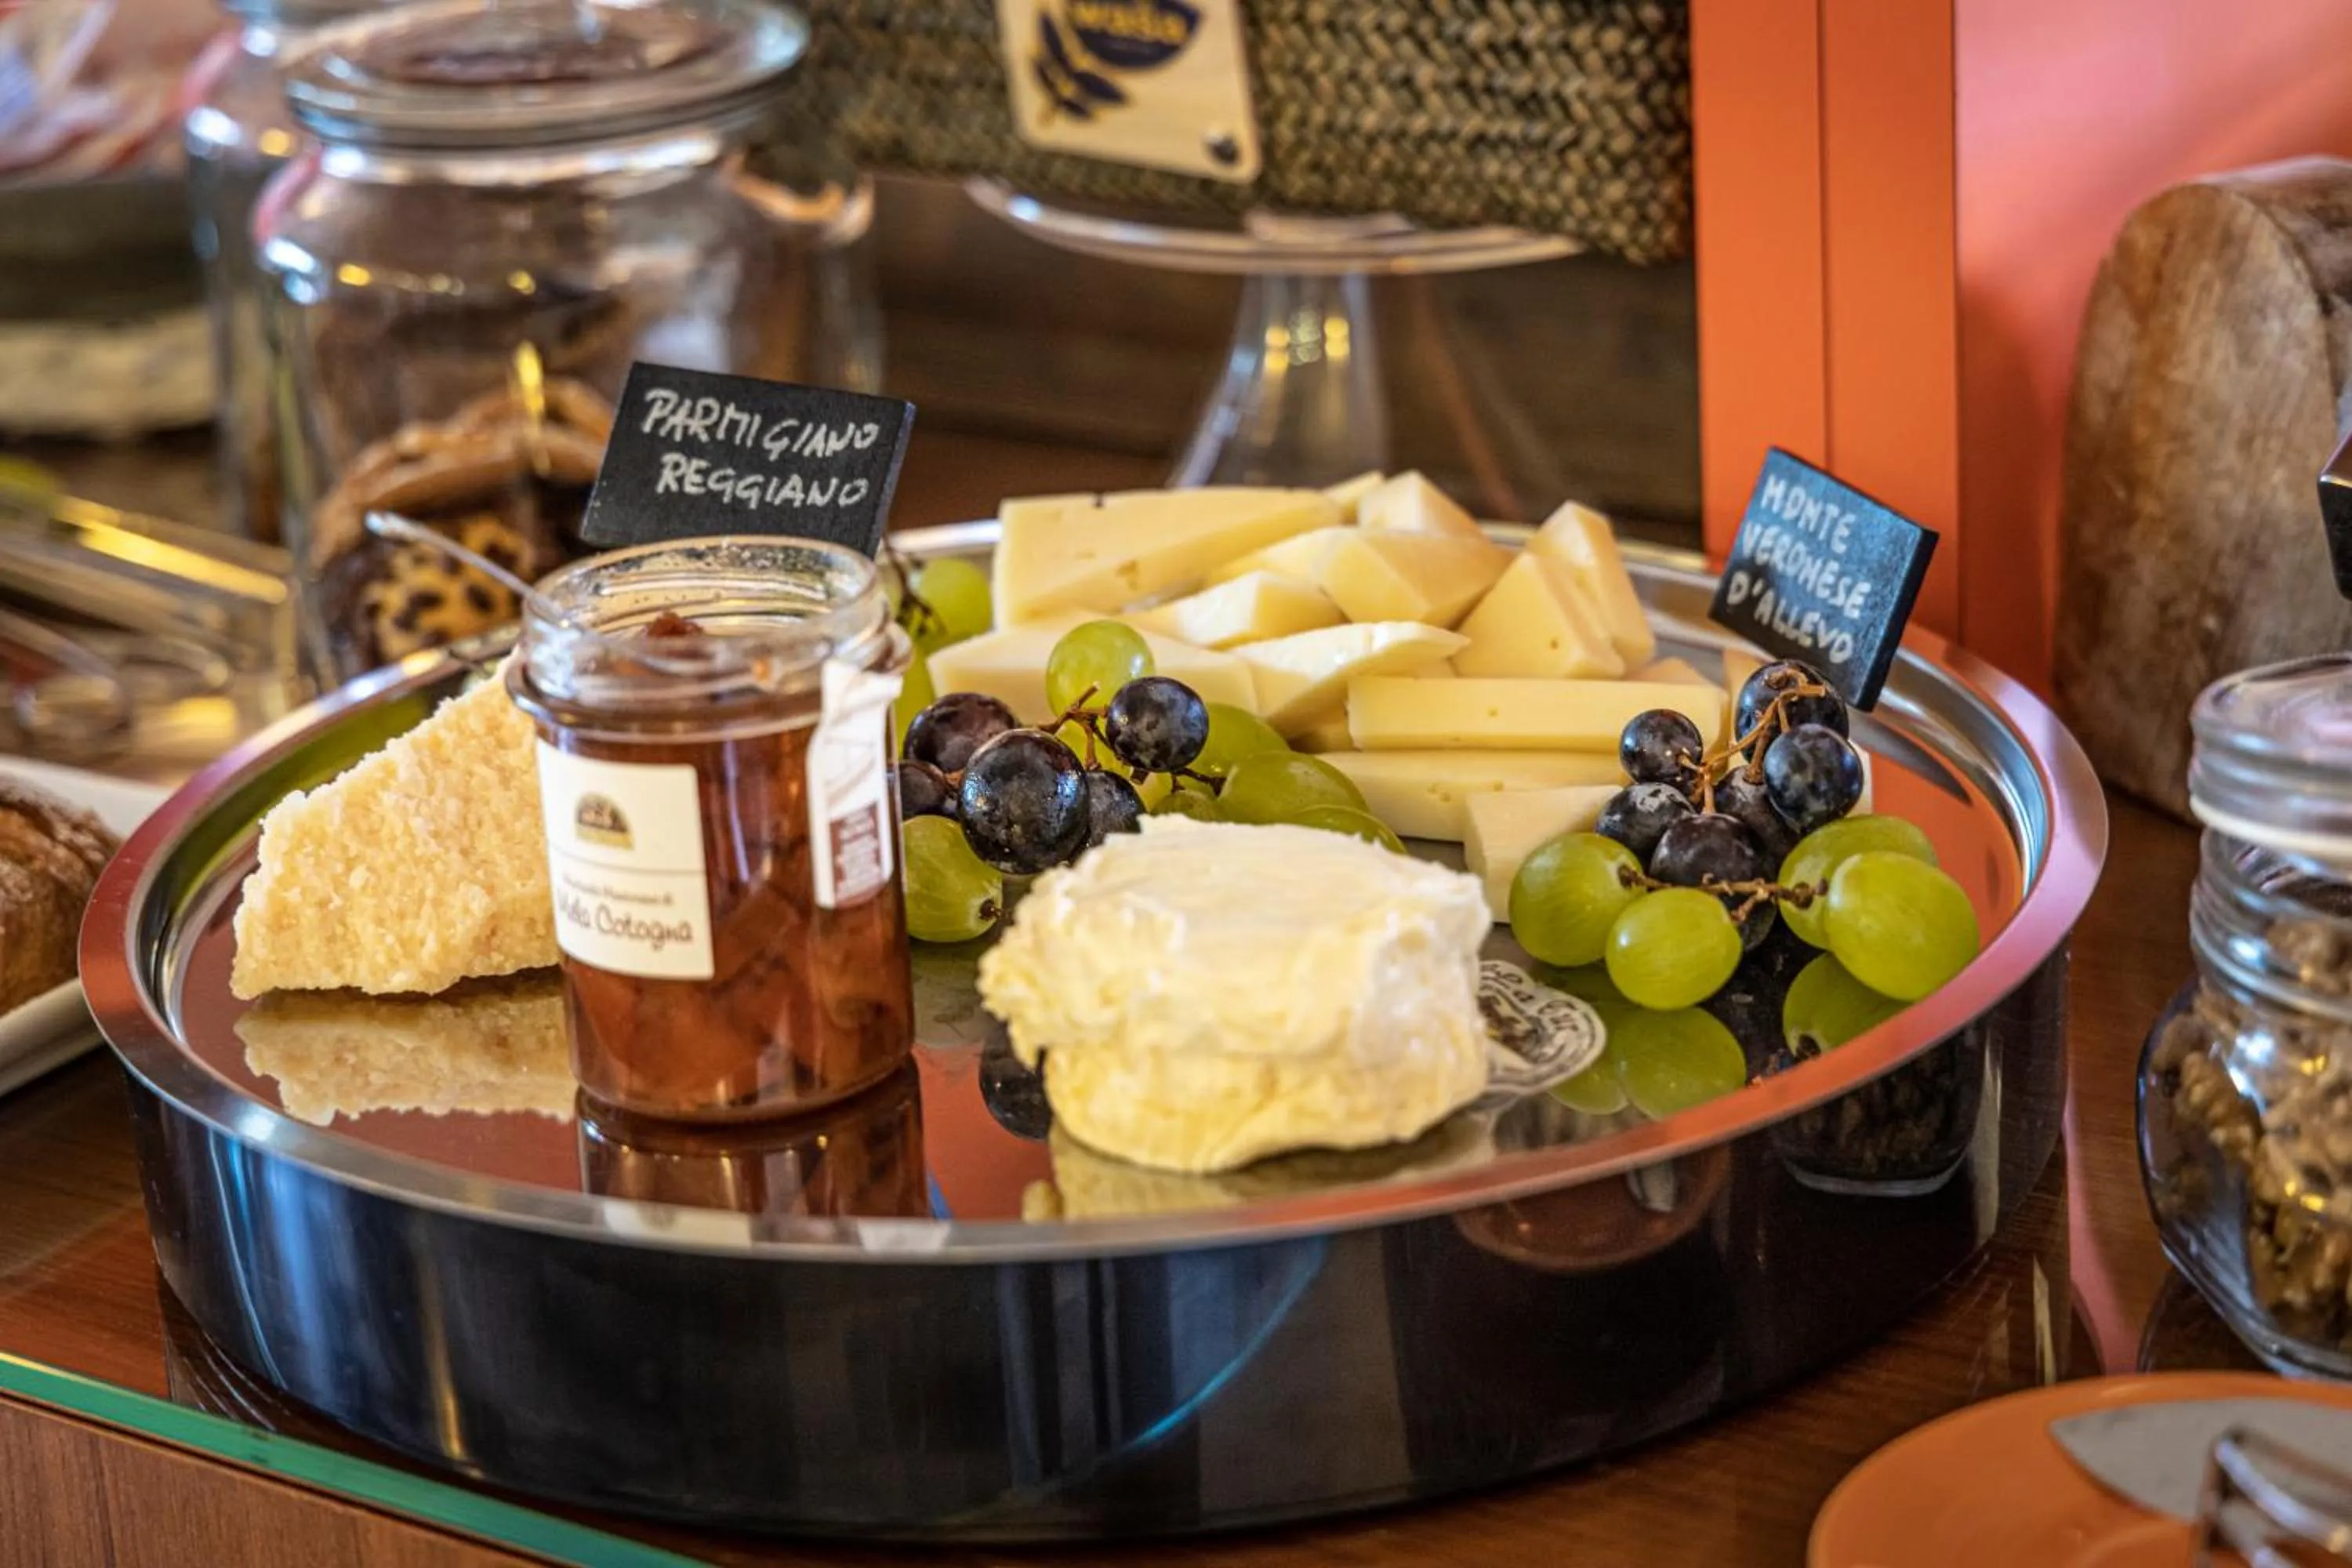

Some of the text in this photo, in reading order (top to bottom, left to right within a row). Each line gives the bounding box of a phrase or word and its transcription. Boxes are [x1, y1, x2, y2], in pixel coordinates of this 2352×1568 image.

[641, 388, 880, 461] PARMIGIANO
[656, 452, 869, 510] REGGIANO
[1761, 474, 1857, 554] MONTE
[1741, 520, 1871, 620] VERONESE
[1726, 570, 1855, 664] D'ALLEVO
[595, 902, 693, 952] Cotogna
